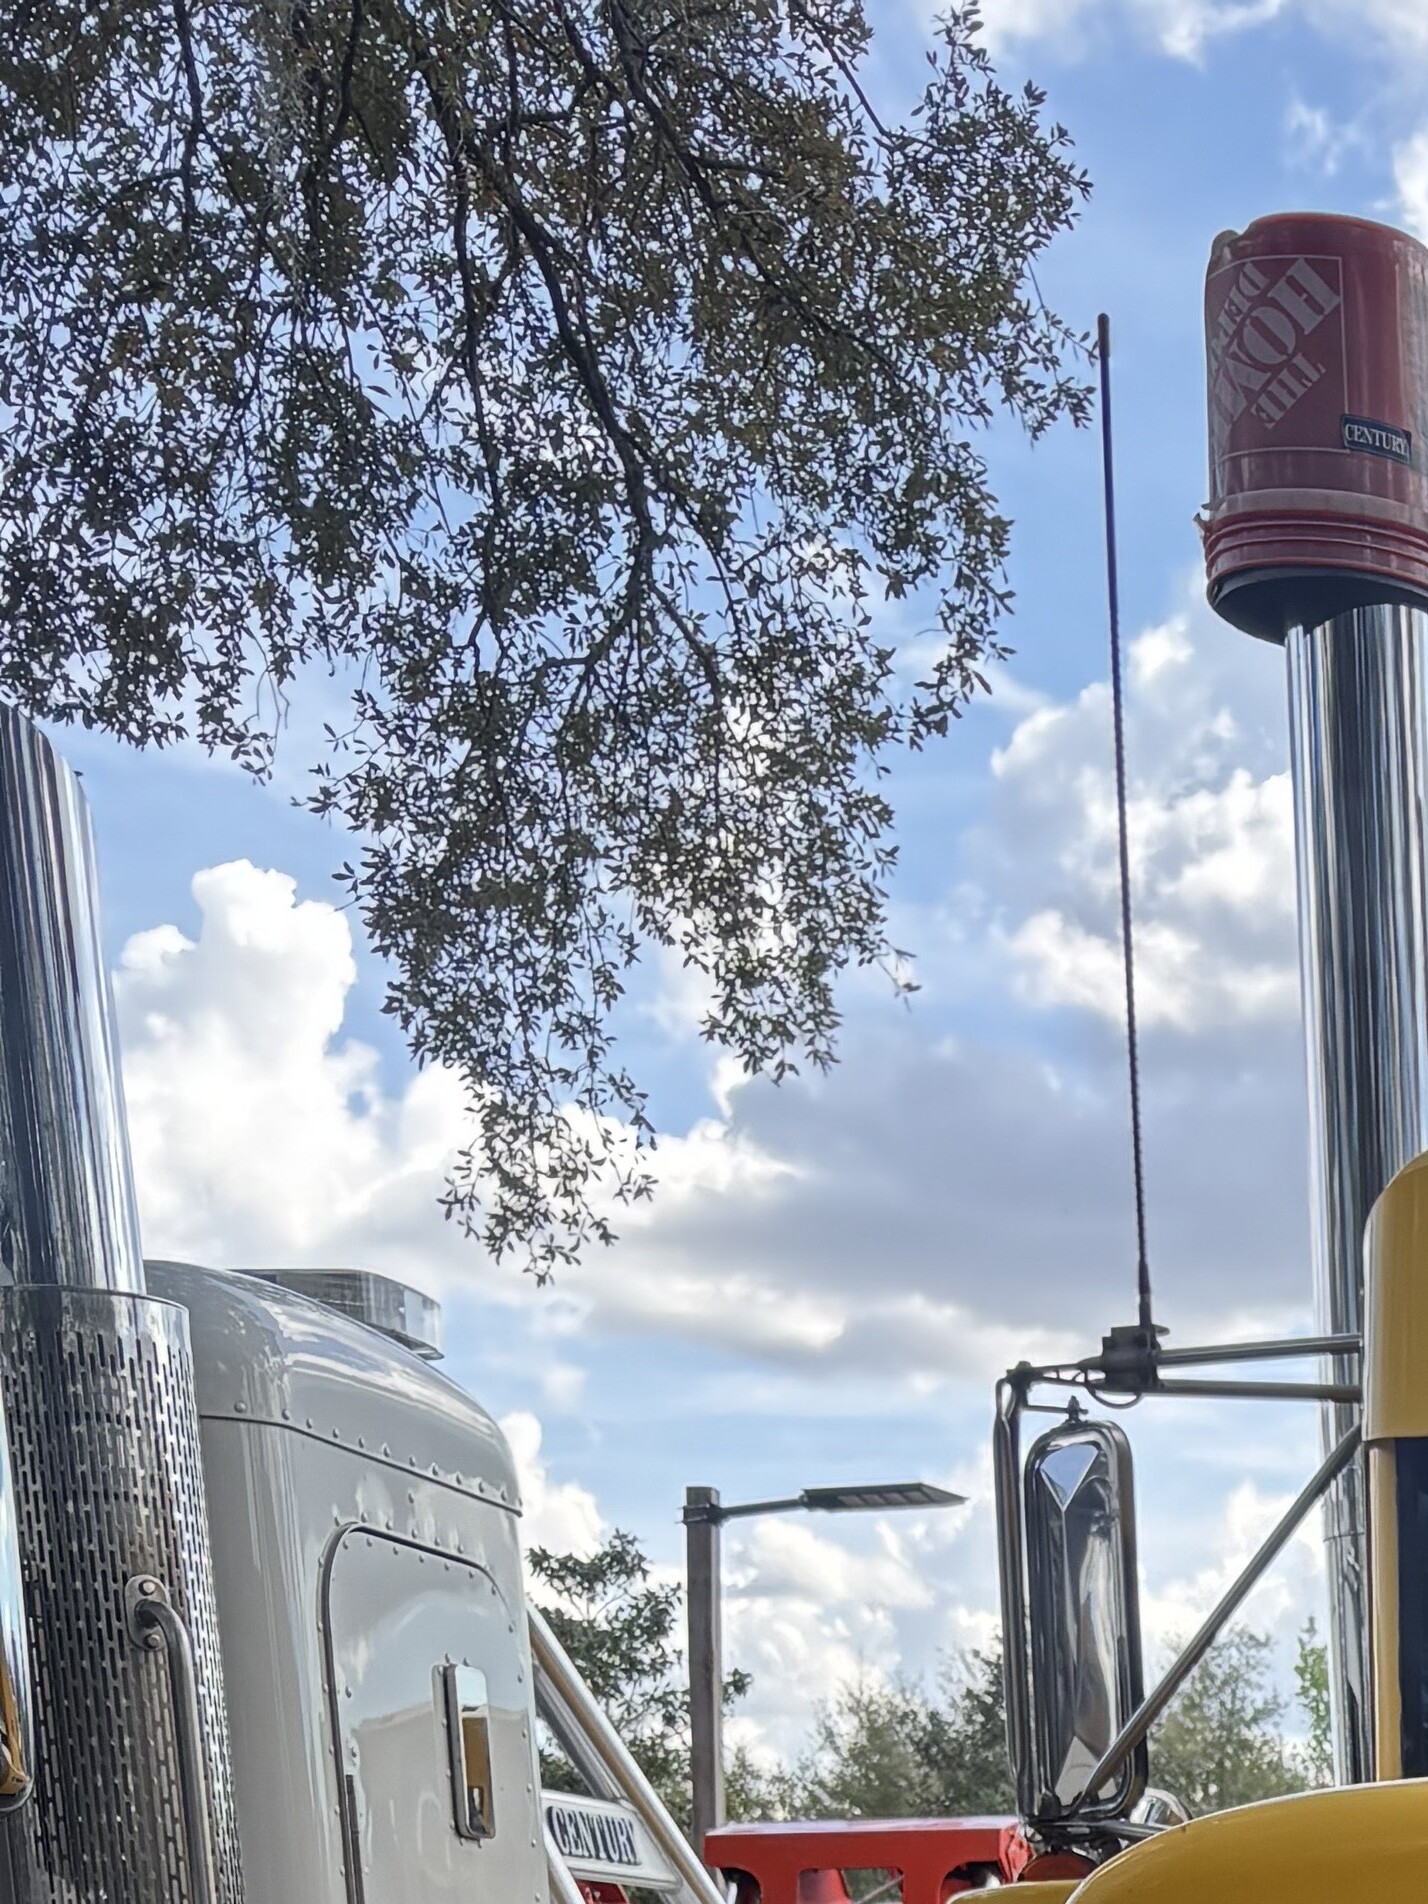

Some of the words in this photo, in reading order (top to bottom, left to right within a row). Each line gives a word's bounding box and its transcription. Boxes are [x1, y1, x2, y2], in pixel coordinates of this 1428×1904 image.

[1251, 352, 1326, 430] THE
[1344, 422, 1409, 456] CENTURY
[546, 1805, 642, 1867] CENTURY
